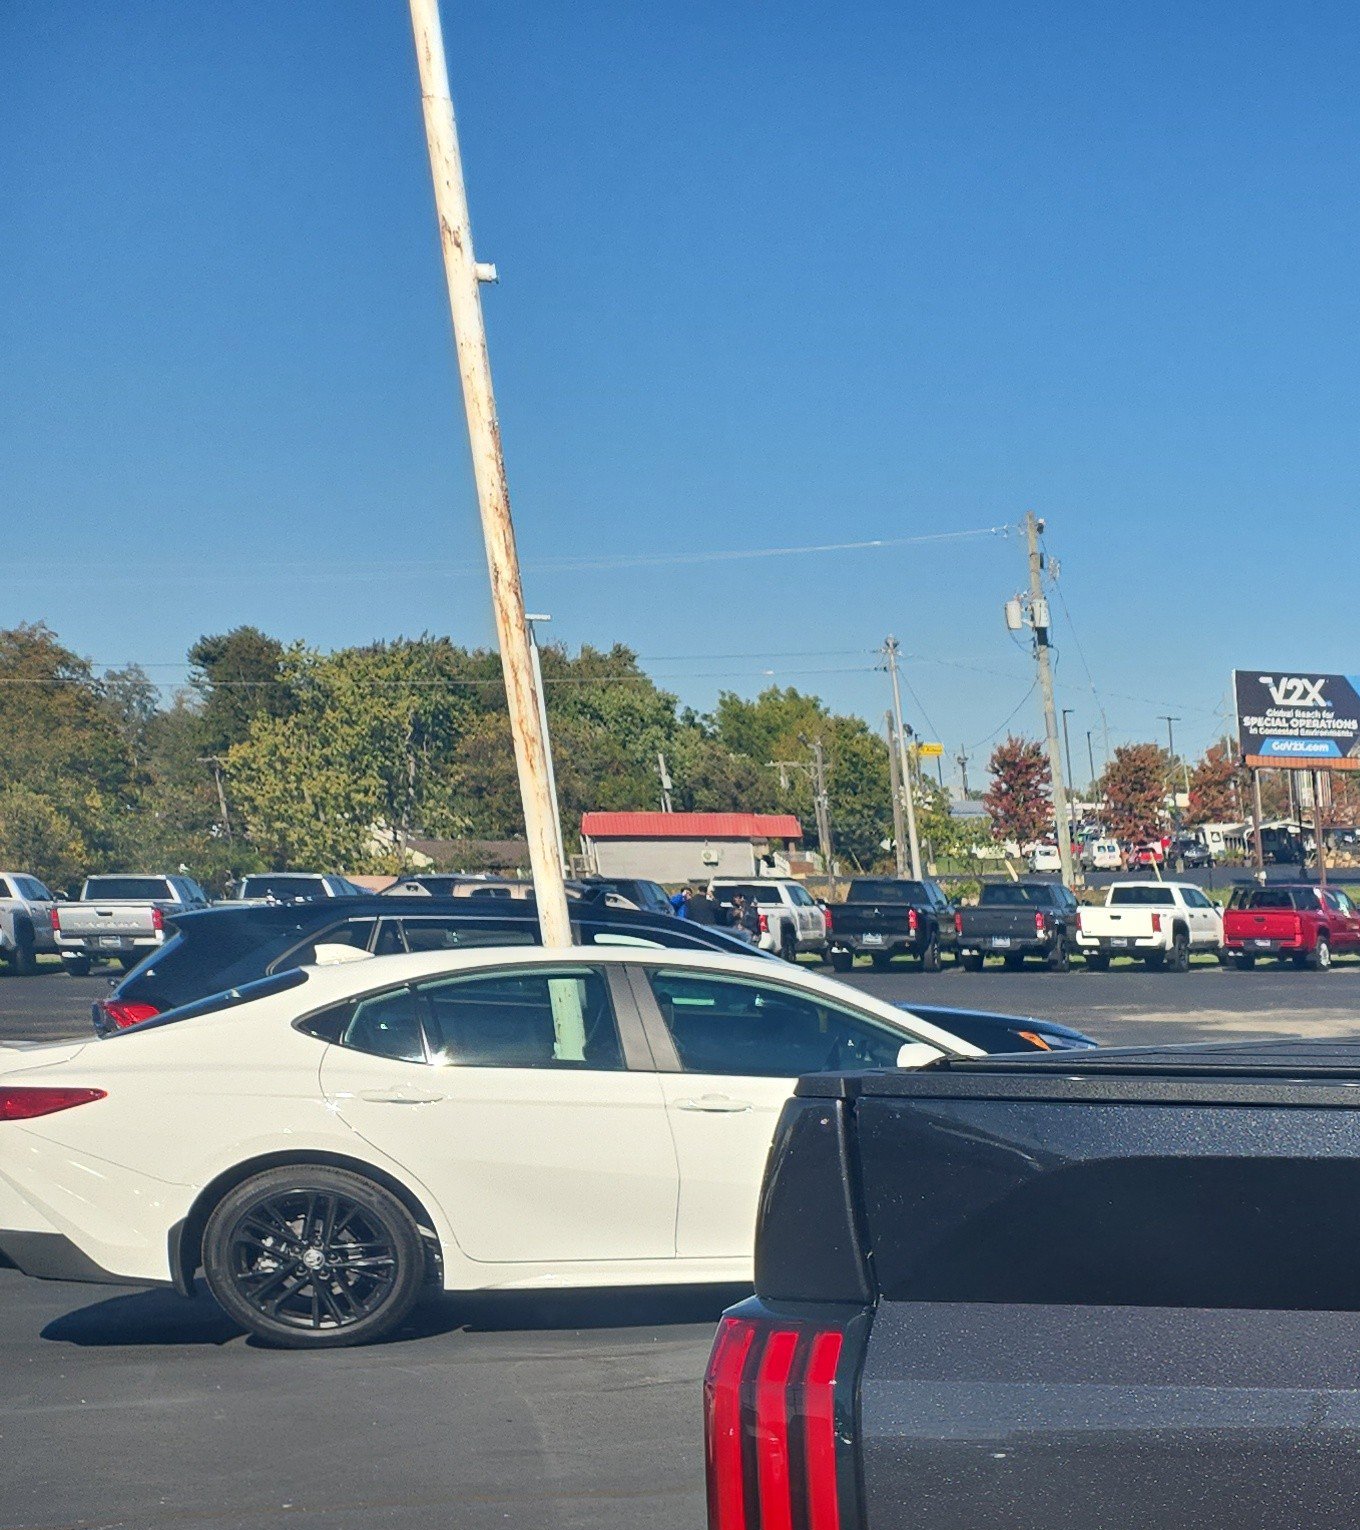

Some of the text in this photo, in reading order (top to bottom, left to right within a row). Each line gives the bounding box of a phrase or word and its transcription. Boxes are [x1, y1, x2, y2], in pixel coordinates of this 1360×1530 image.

[1259, 676, 1328, 707] V2X
[1266, 708, 1335, 720] Global Reach for
[1243, 715, 1358, 730] SPECIAL OPERATIONS
